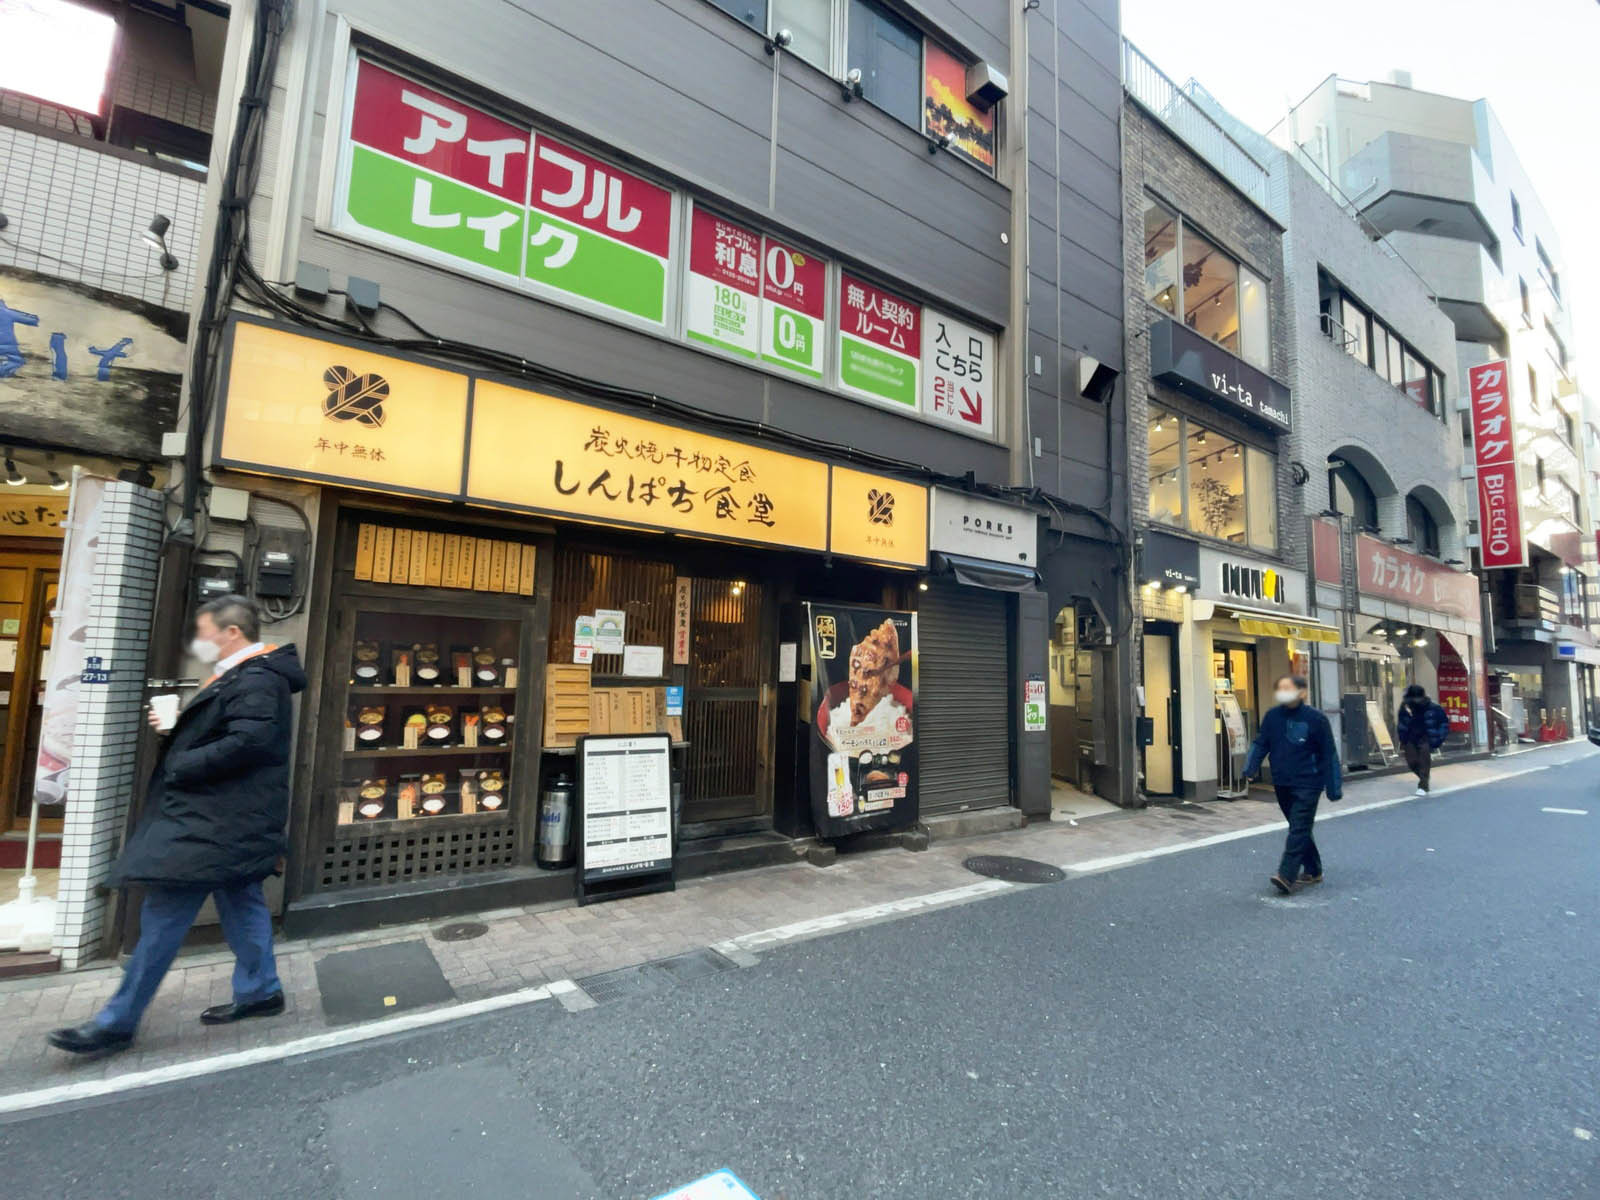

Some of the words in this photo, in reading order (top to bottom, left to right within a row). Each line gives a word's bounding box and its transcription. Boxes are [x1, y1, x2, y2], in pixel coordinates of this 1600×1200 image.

[401, 89, 642, 233] アイフル
[411, 177, 578, 268] レイク
[714, 242, 758, 278] 利息
[847, 284, 914, 330] 無人契約
[856, 312, 906, 349] ルーム
[935, 322, 983, 360] 入口
[936, 348, 983, 383] こちら
[934, 376, 945, 411] 2F
[1211, 372, 1254, 408] vi-ta
[1258, 400, 1289, 426] tamachi
[1476, 369, 1509, 460] カラオケ
[314, 437, 387, 462] 年中無休
[583, 425, 757, 484] 炭火焼干物定食
[554, 459, 776, 528] しんぱち食堂
[1484, 473, 1505, 507] BIG
[1489, 508, 1510, 556] ECHO
